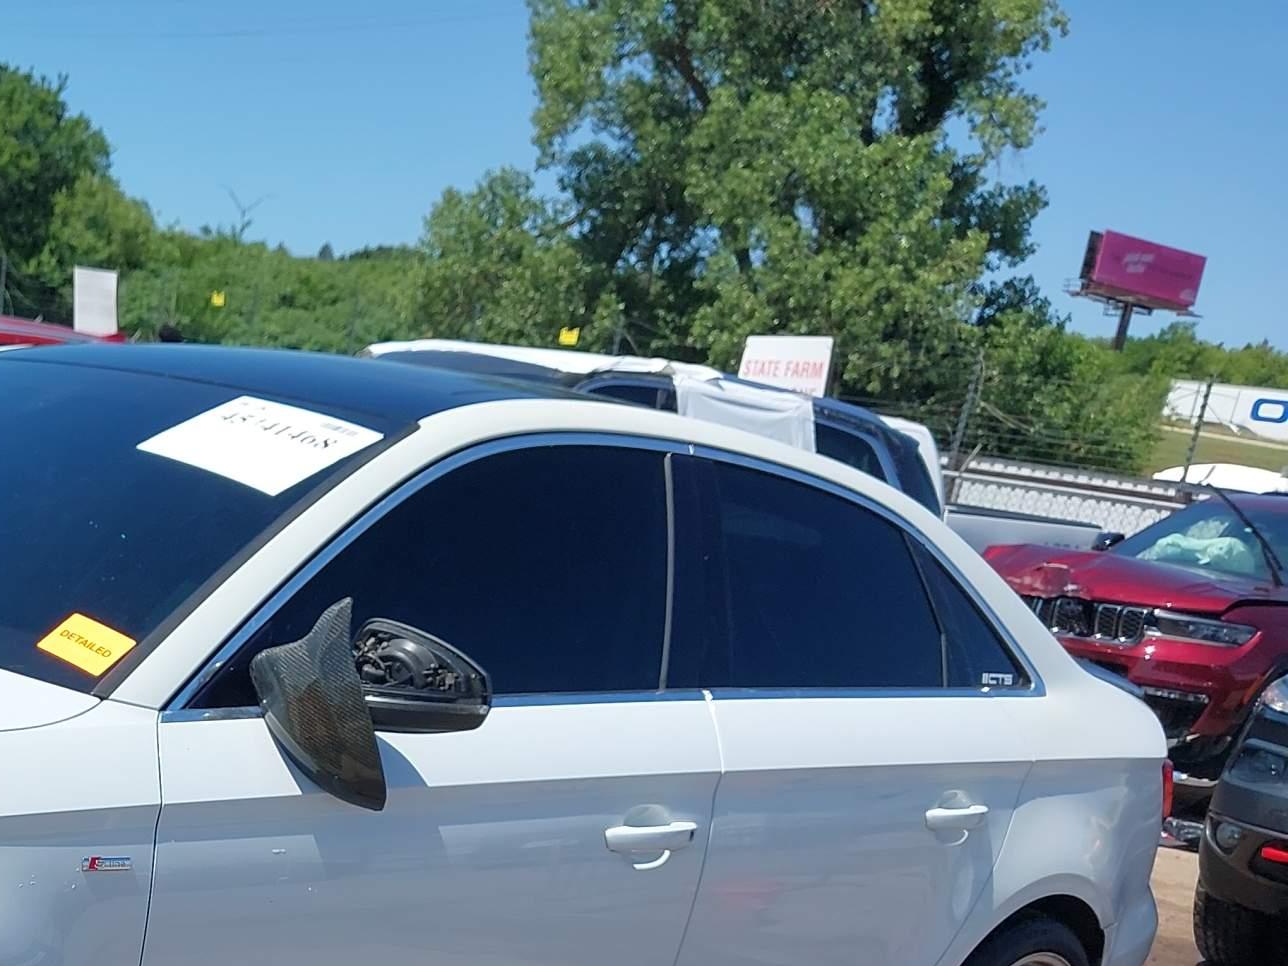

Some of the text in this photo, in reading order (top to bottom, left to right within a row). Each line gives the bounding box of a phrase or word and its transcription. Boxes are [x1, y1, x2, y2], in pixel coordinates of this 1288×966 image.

[743, 360, 824, 378] STATE FARM
[59, 629, 112, 658] DETAILED
